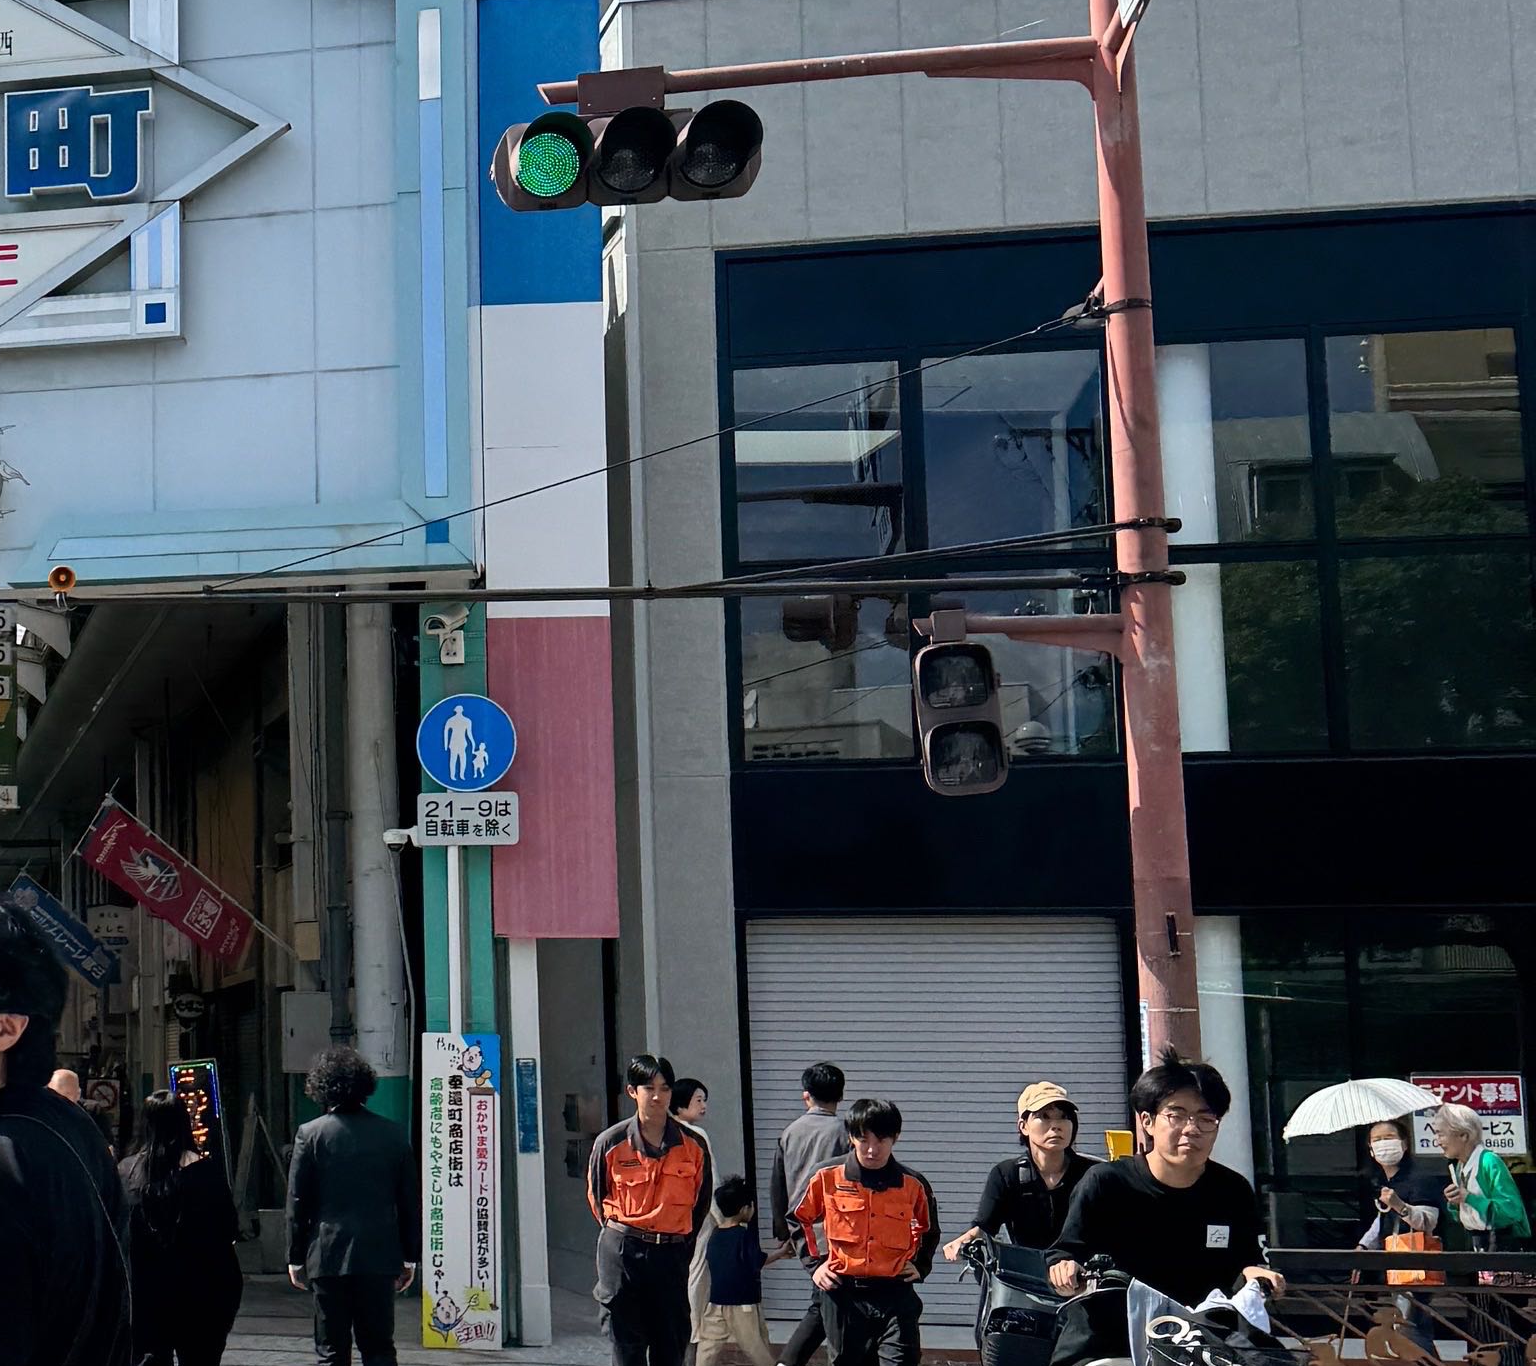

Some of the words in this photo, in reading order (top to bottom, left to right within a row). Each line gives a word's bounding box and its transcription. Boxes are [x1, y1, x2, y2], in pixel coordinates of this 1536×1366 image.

[425, 819, 511, 837] 自転車を除く
[1418, 1082, 1518, 1104] テナント募集
[447, 1074, 464, 1188] 奉還町商店街は
